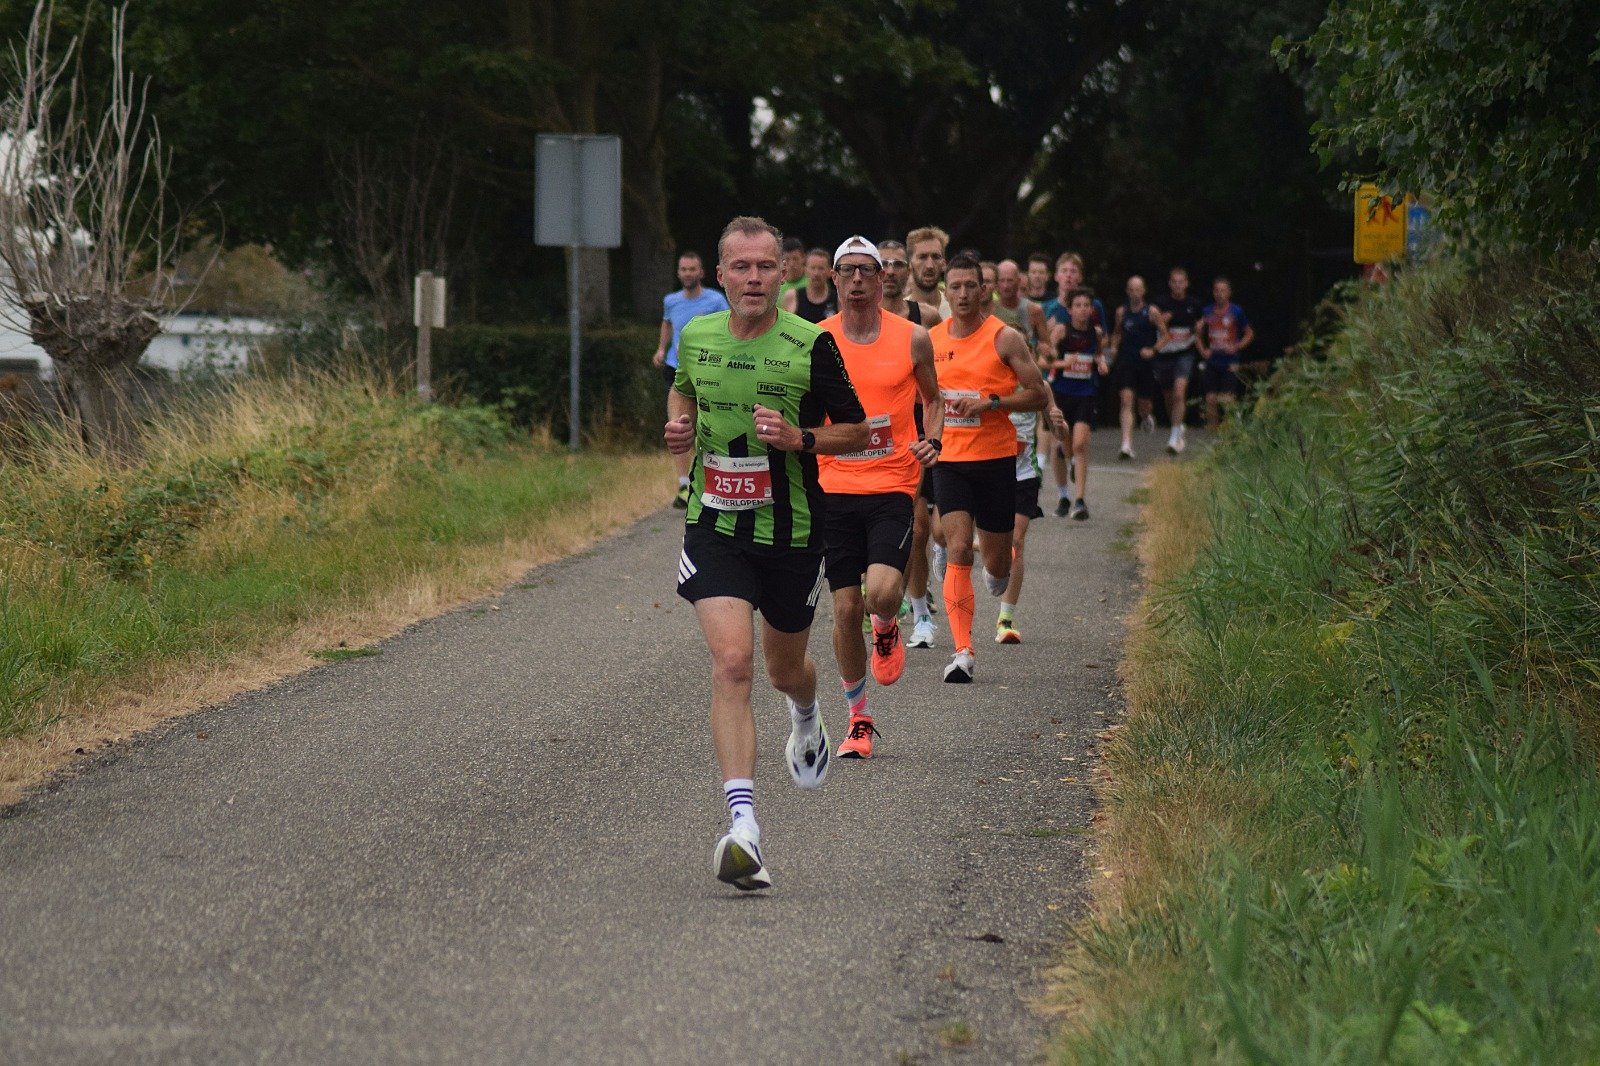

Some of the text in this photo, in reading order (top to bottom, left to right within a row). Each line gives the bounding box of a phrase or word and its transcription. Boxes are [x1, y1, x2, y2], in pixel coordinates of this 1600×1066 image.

[726, 360, 756, 371] Athlex
[870, 432, 881, 446] 6
[845, 448, 887, 458] OMERLOPEN
[714, 475, 756, 494] 2575
[711, 496, 763, 506] ZOMERLOPEN
